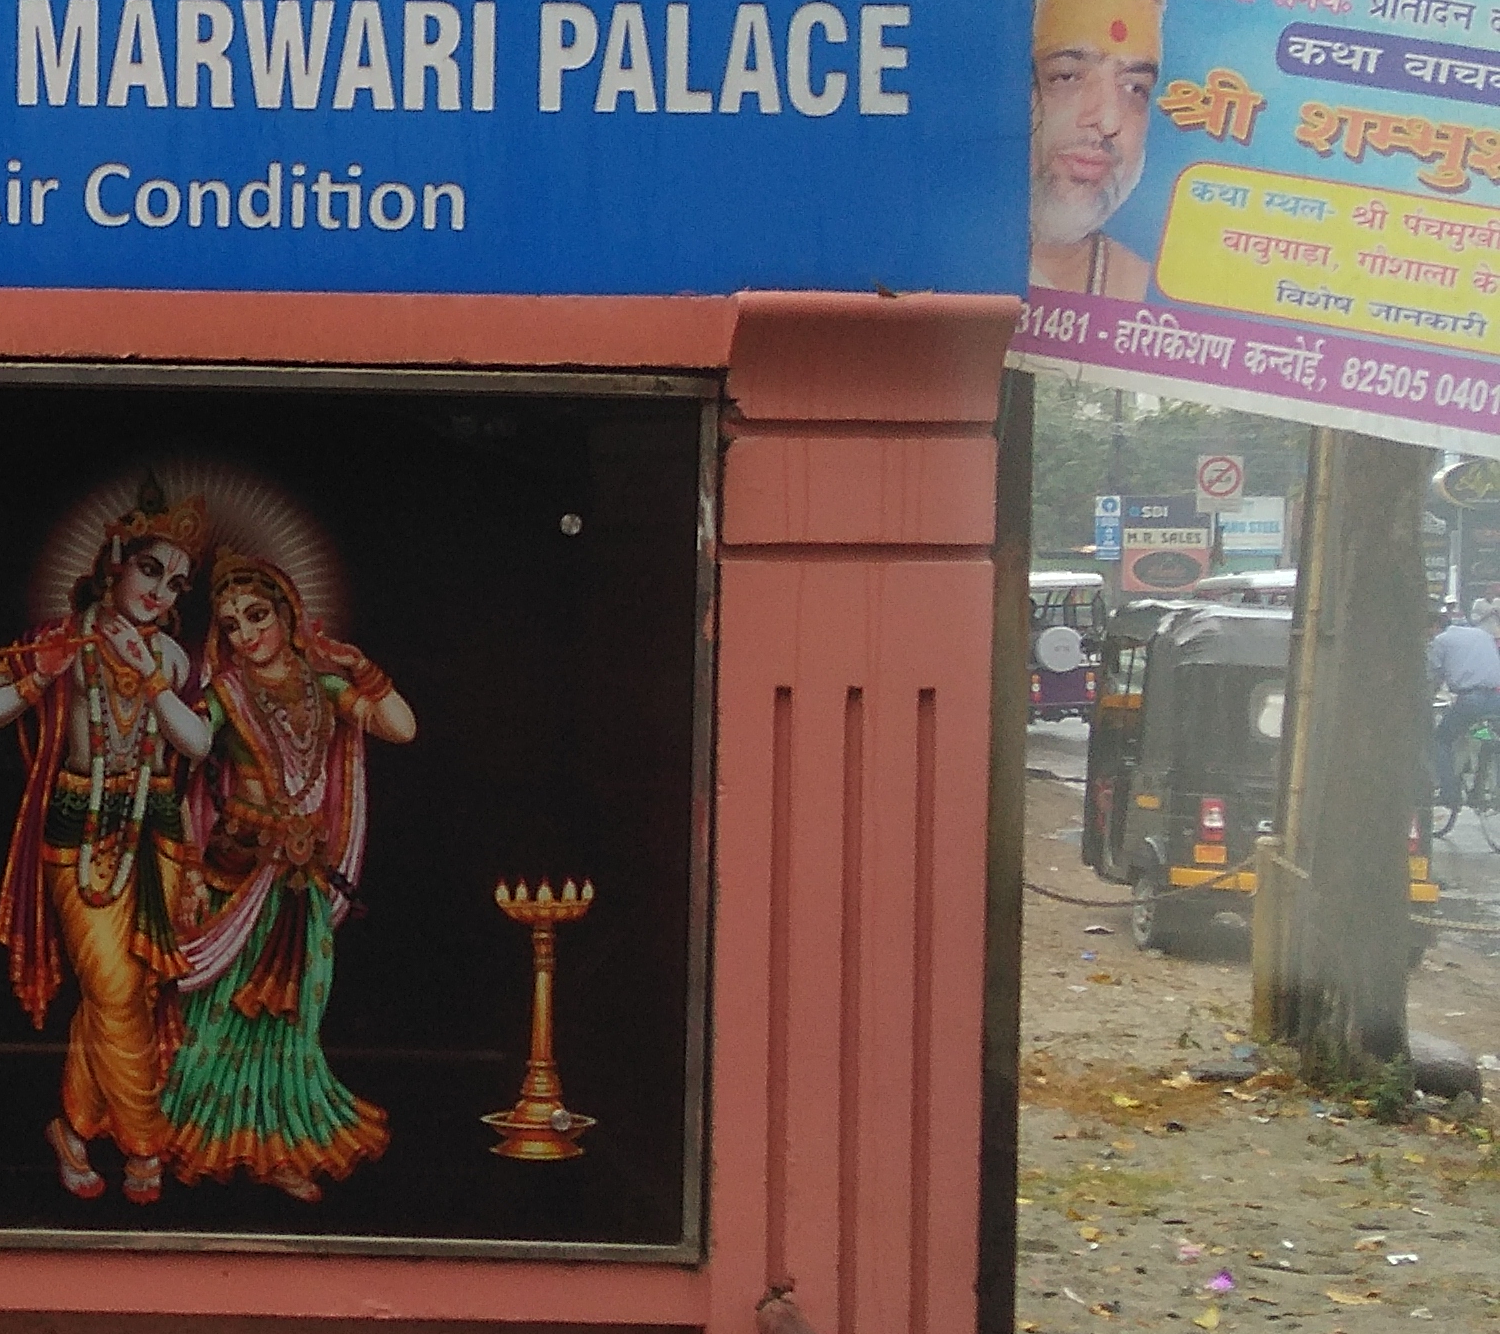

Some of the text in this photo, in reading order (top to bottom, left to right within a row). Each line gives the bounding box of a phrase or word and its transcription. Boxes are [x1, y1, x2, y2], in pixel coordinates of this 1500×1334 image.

[539, 1, 912, 116] PALACE
[1288, 35, 1384, 73] कथा
[1157, 67, 1267, 146] श्री
[84, 162, 466, 231] Condition
[1190, 180, 1250, 209] कथा
[1352, 199, 1388, 231] श्री
[1275, 279, 1488, 338] विशेष जानकारी
[1341, 357, 1430, 402] 82505
